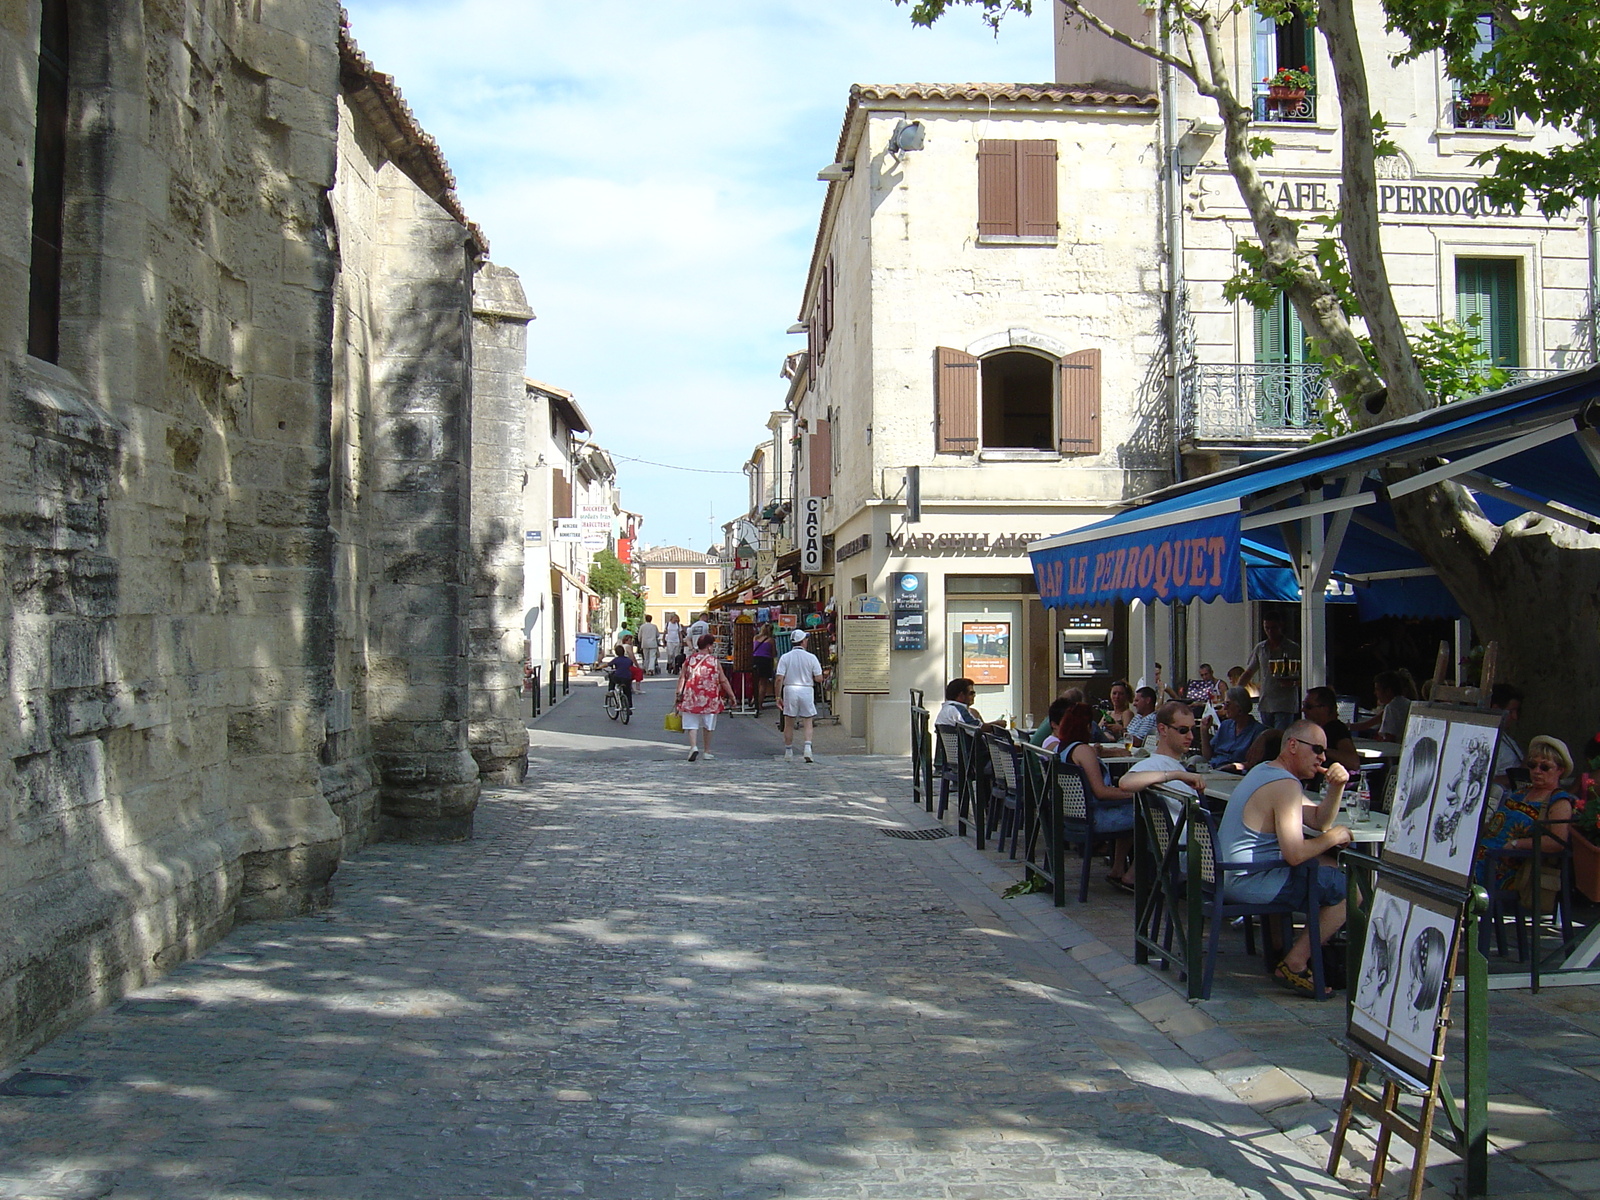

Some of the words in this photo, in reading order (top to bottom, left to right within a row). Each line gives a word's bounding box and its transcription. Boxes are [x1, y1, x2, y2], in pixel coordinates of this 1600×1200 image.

[1380, 185, 1521, 219] PERROQU
[806, 499, 819, 564] CACAO
[1037, 560, 1063, 597] BAR
[1068, 556, 1088, 594] LE
[1092, 536, 1226, 597] PERROQUET
